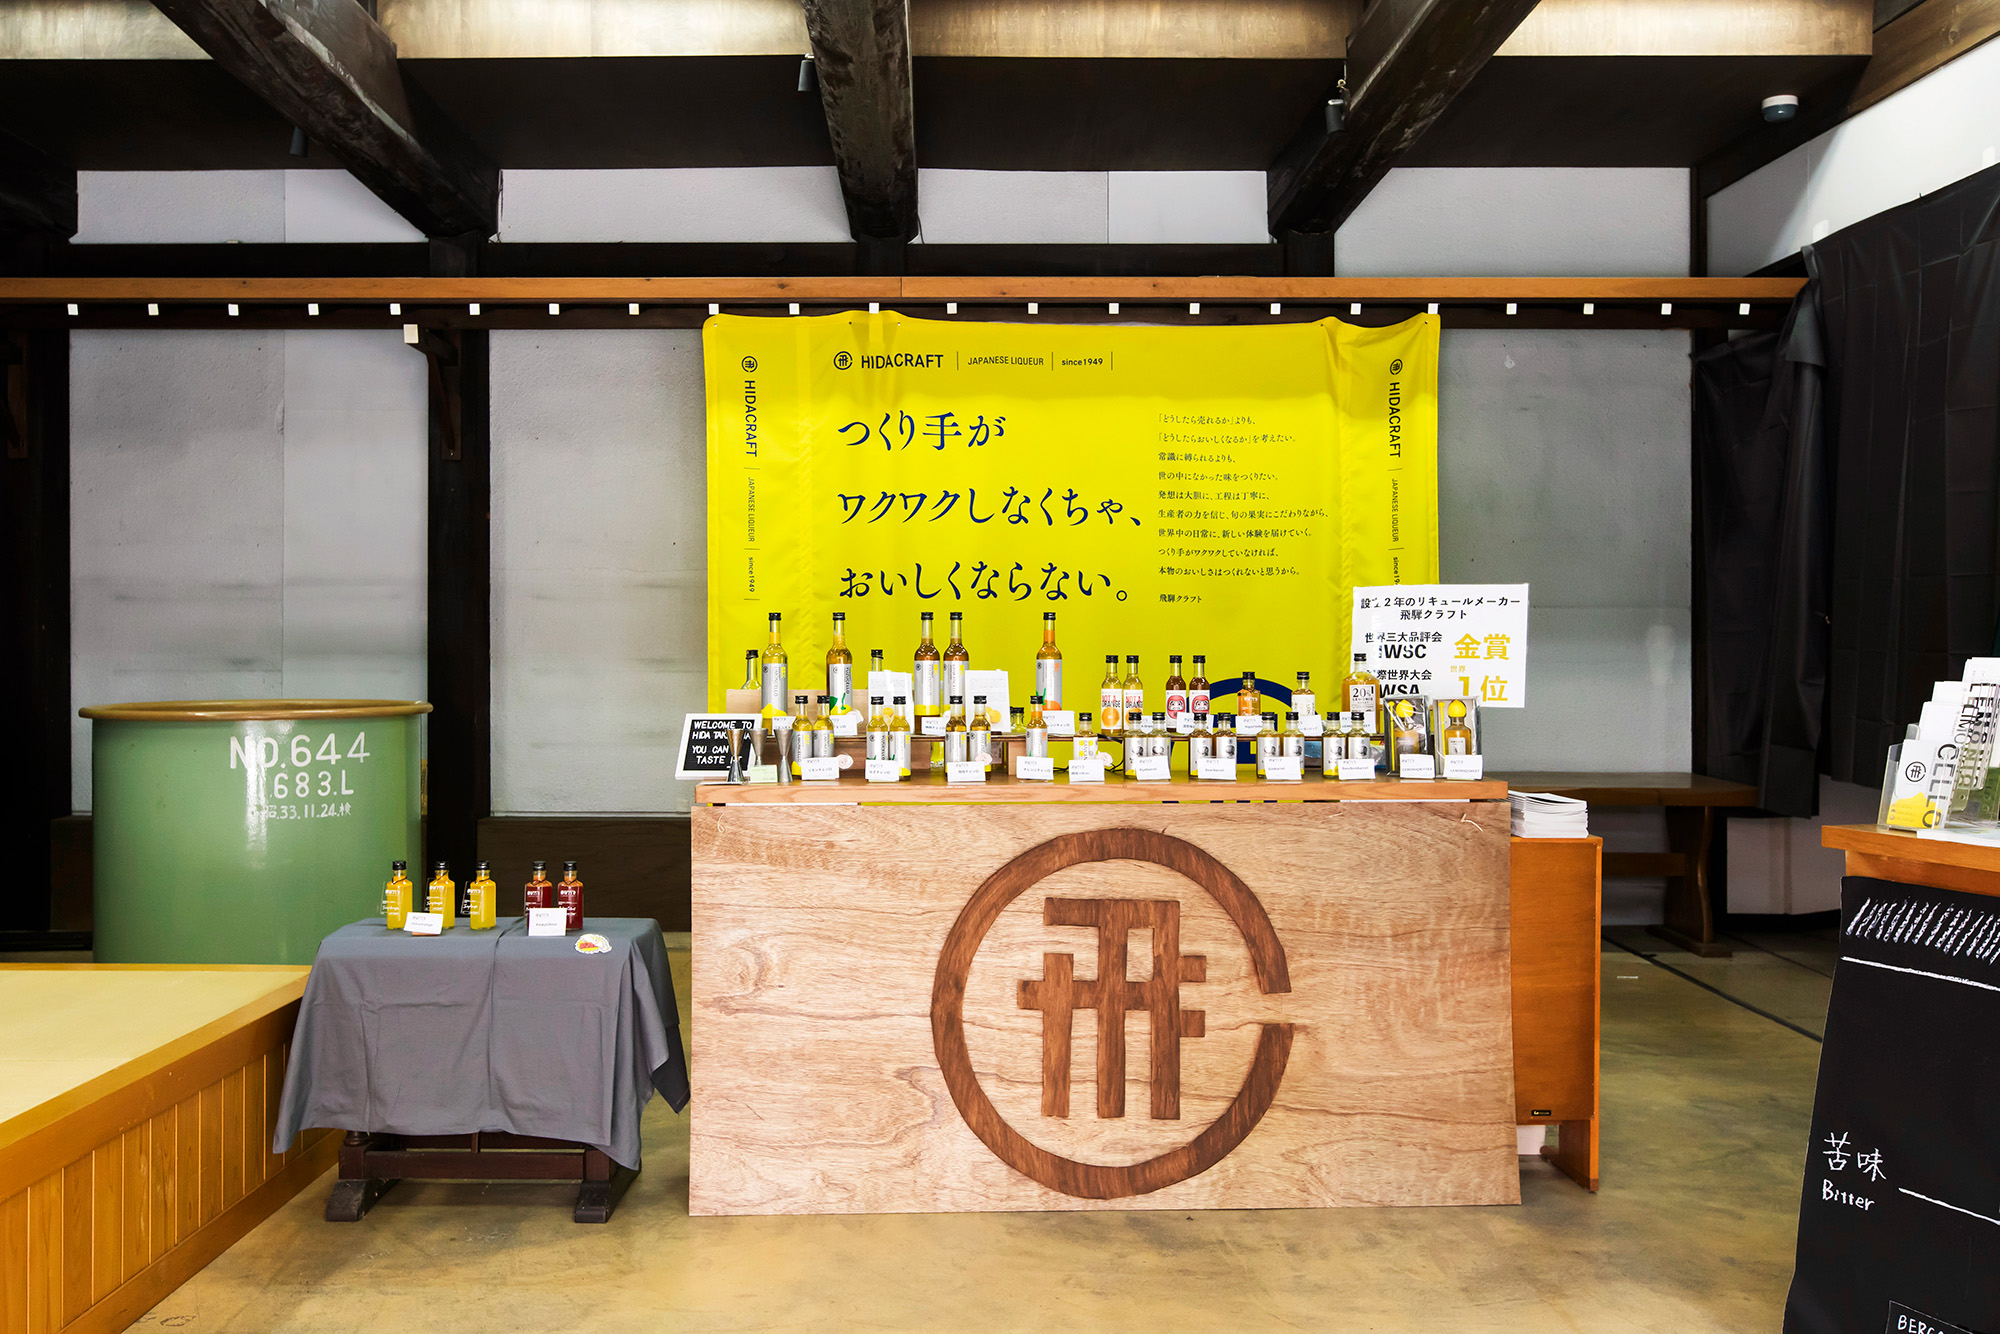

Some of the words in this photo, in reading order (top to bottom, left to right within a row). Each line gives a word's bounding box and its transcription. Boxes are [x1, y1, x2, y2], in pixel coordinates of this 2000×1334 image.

[860, 352, 944, 370] HIDACRAFT
[967, 355, 1010, 366] JAPANESE
[1011, 356, 1044, 367] LIQUEUR
[1061, 357, 1104, 367] since1949
[743, 379, 758, 458] HIDACRAFT
[837, 409, 1007, 452] つくり手が
[1388, 381, 1402, 458] HIDACRAFT
[747, 476, 755, 514] JAPANESE
[837, 485, 1142, 527] ワクワクしなくちゃ、
[747, 515, 756, 543] LIQUEUR
[1391, 512, 1400, 543] LIQUEUR
[839, 560, 1128, 602] おいしくならない。
[1399, 609, 1468, 621] 飛騨クラフト
[1453, 632, 1511, 661] 金賞
[1450, 665, 1466, 673] 世界
[691, 730, 711, 740] HIDA
[694, 721, 736, 730] WELCOME
[741, 721, 753, 730] TO
[691, 745, 707, 754] YOU
[711, 745, 729, 754] CAN
[696, 755, 726, 765] TASTE
[1822, 1131, 1887, 1182] 苦味
[1822, 1178, 1875, 1211] Bitter
